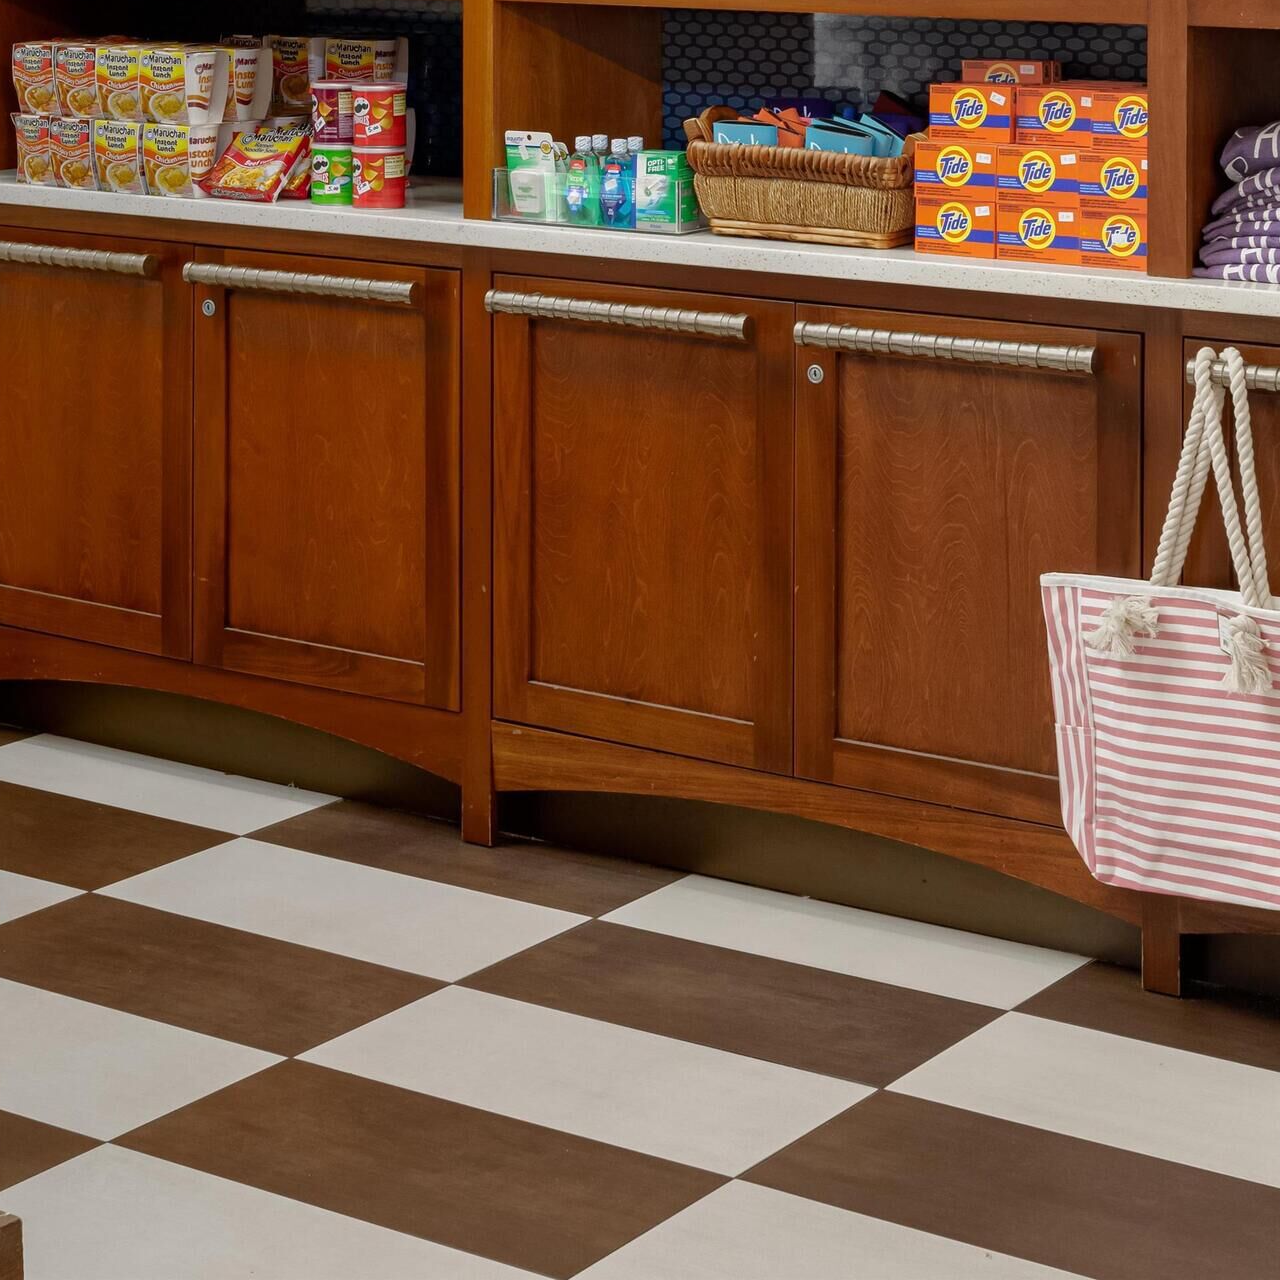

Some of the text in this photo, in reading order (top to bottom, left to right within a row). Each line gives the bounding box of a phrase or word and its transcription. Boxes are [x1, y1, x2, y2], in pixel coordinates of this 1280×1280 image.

[105, 54, 137, 65] Maruchan
[107, 64, 129, 72] Instant
[953, 98, 984, 122] Tide
[1041, 101, 1072, 124] Tide
[939, 154, 969, 178] Tide
[1022, 158, 1052, 182] Tide
[1104, 166, 1135, 190] Tide
[1021, 215, 1052, 240] Tide
